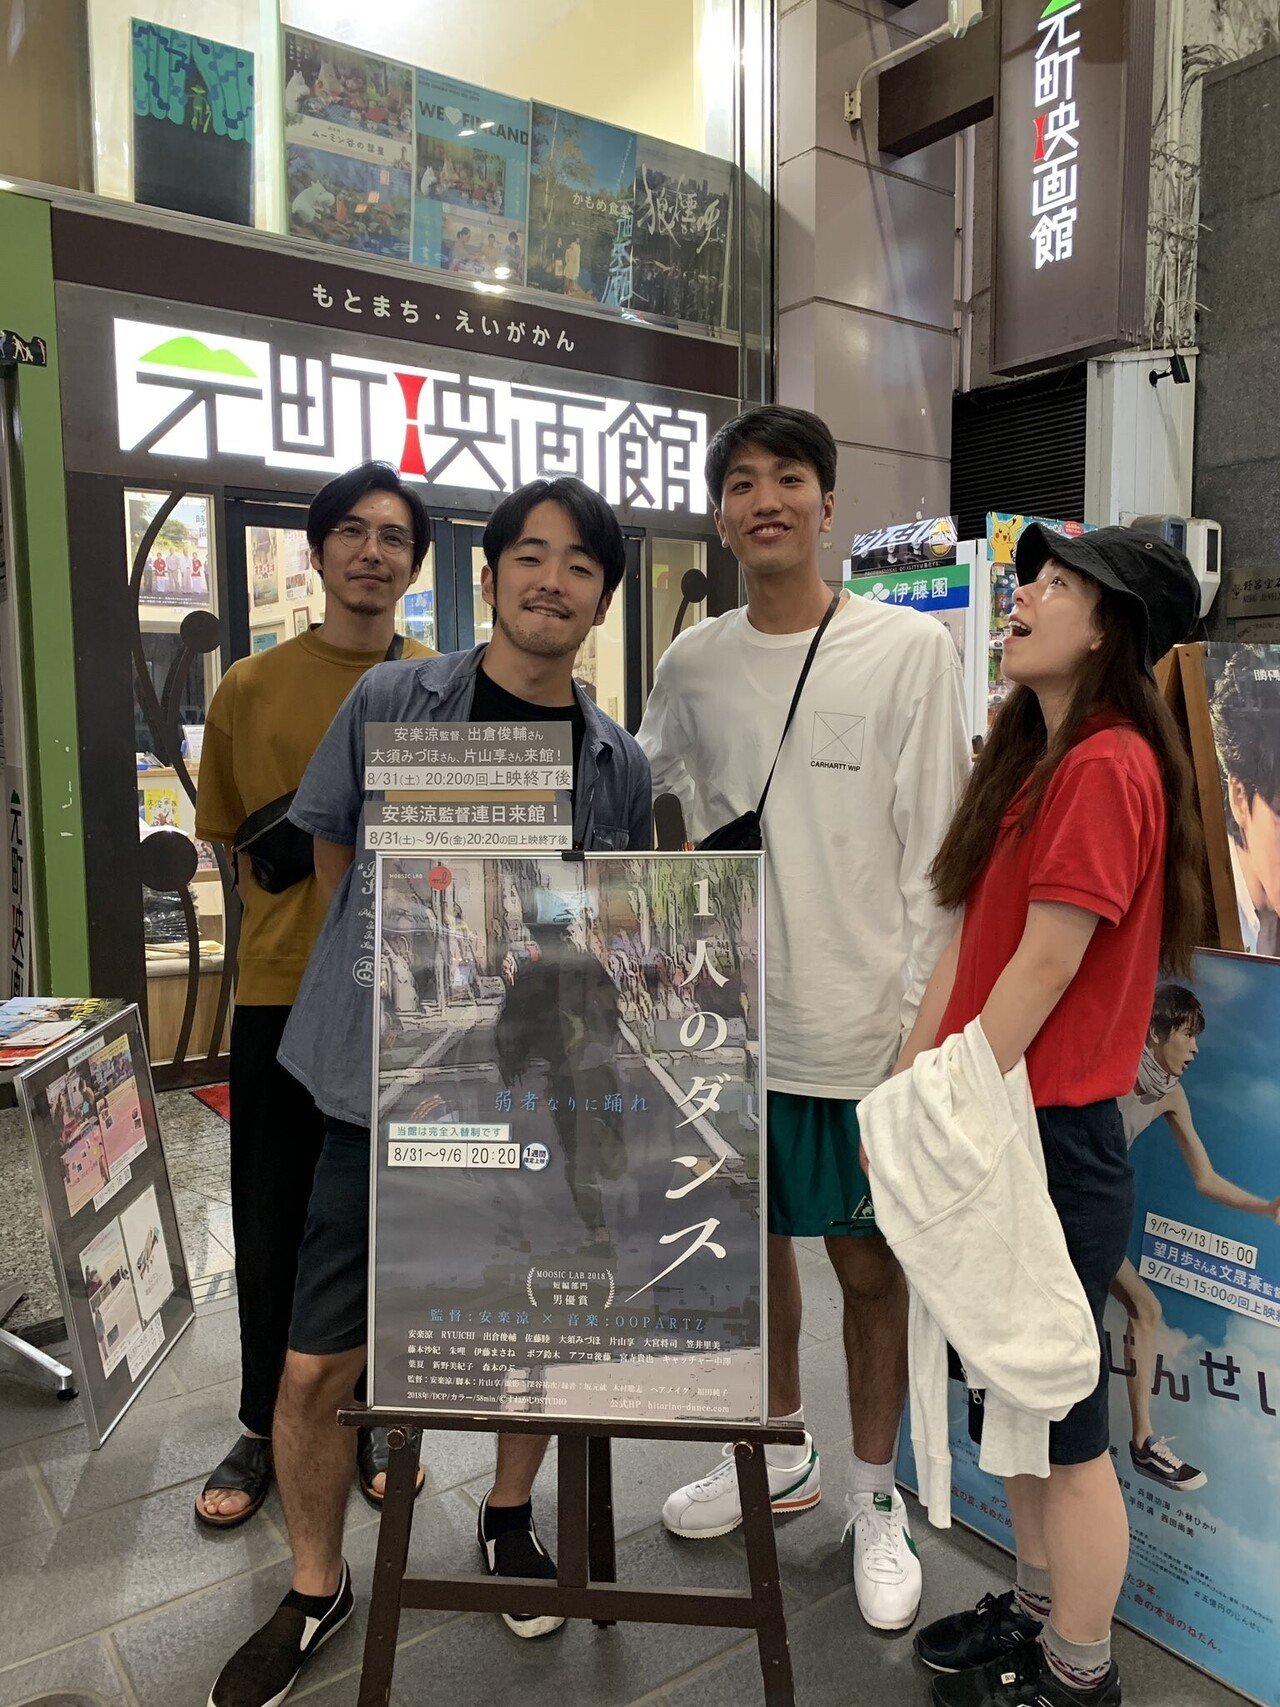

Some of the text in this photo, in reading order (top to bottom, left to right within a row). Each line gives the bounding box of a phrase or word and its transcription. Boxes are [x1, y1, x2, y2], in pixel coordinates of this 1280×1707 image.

[418, 100, 445, 121] WE
[1030, 1, 1081, 270] 元町映画館
[312, 283, 575, 352] もとまち・えいがかん
[126, 335, 702, 512] 元町映画館
[892, 577, 948, 603] 伊藤園
[394, 726, 543, 742] 安楽涼監督、出倉俊輔さん
[811, 761, 860, 772] CARHARTT WIP
[367, 769, 570, 786] 8/31(土) 20:20の回上映終了後
[625, 878, 731, 1303] 1人のダンス
[494, 1089, 649, 1113] 弱者なりに踊れ
[397, 1126, 502, 1138] 当館は完全入替制です
[471, 1147, 517, 1165] 20:20
[1215, 1239, 1254, 1265] 15:00
[569, 1272, 585, 1280] LAB
[588, 1272, 606, 1280] 2018
[553, 1294, 588, 1306] 男優賞
[407, 1330, 433, 1339] 安楽涼
[441, 1331, 475, 1340] RYUICHI
